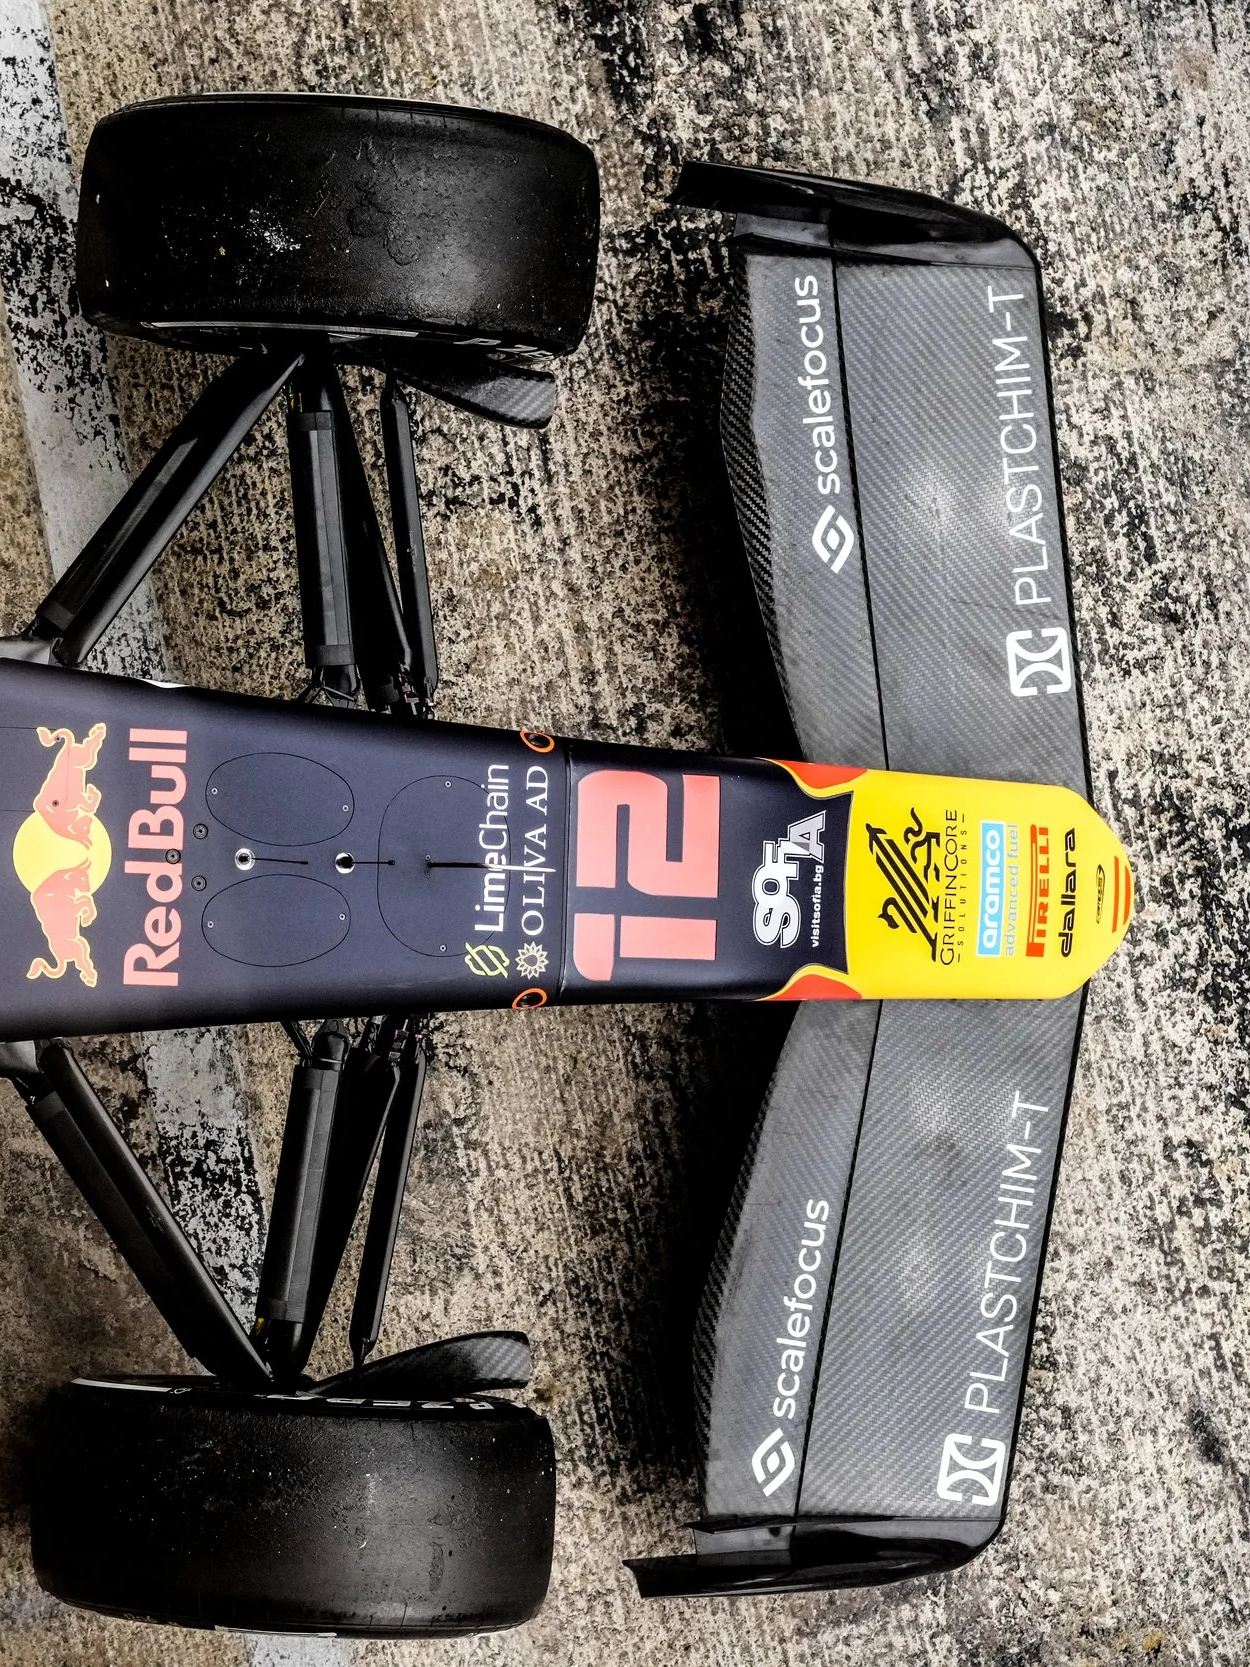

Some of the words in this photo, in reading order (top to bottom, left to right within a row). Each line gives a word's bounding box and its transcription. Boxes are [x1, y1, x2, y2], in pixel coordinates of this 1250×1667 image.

[795, 274, 841, 495] scalefocus
[987, 285, 1052, 606] PLASTCHIM-T
[474, 763, 510, 932] LimeChain
[525, 765, 548, 816] AD
[1007, 824, 1019, 858] fuel
[521, 823, 548, 936] OLIVA
[573, 769, 721, 981] 12
[751, 809, 827, 949] SOFIA
[810, 864, 825, 948] visitsofia.bg
[939, 809, 958, 966] GRIFFINCORE
[981, 828, 1002, 950] aramco
[1004, 861, 1020, 957] advanced
[1025, 823, 1049, 958] PIRELLI
[1058, 828, 1077, 958] dallara
[772, 1199, 830, 1420] scalefocus
[965, 1090, 1049, 1414] PLASTCHIM-T
